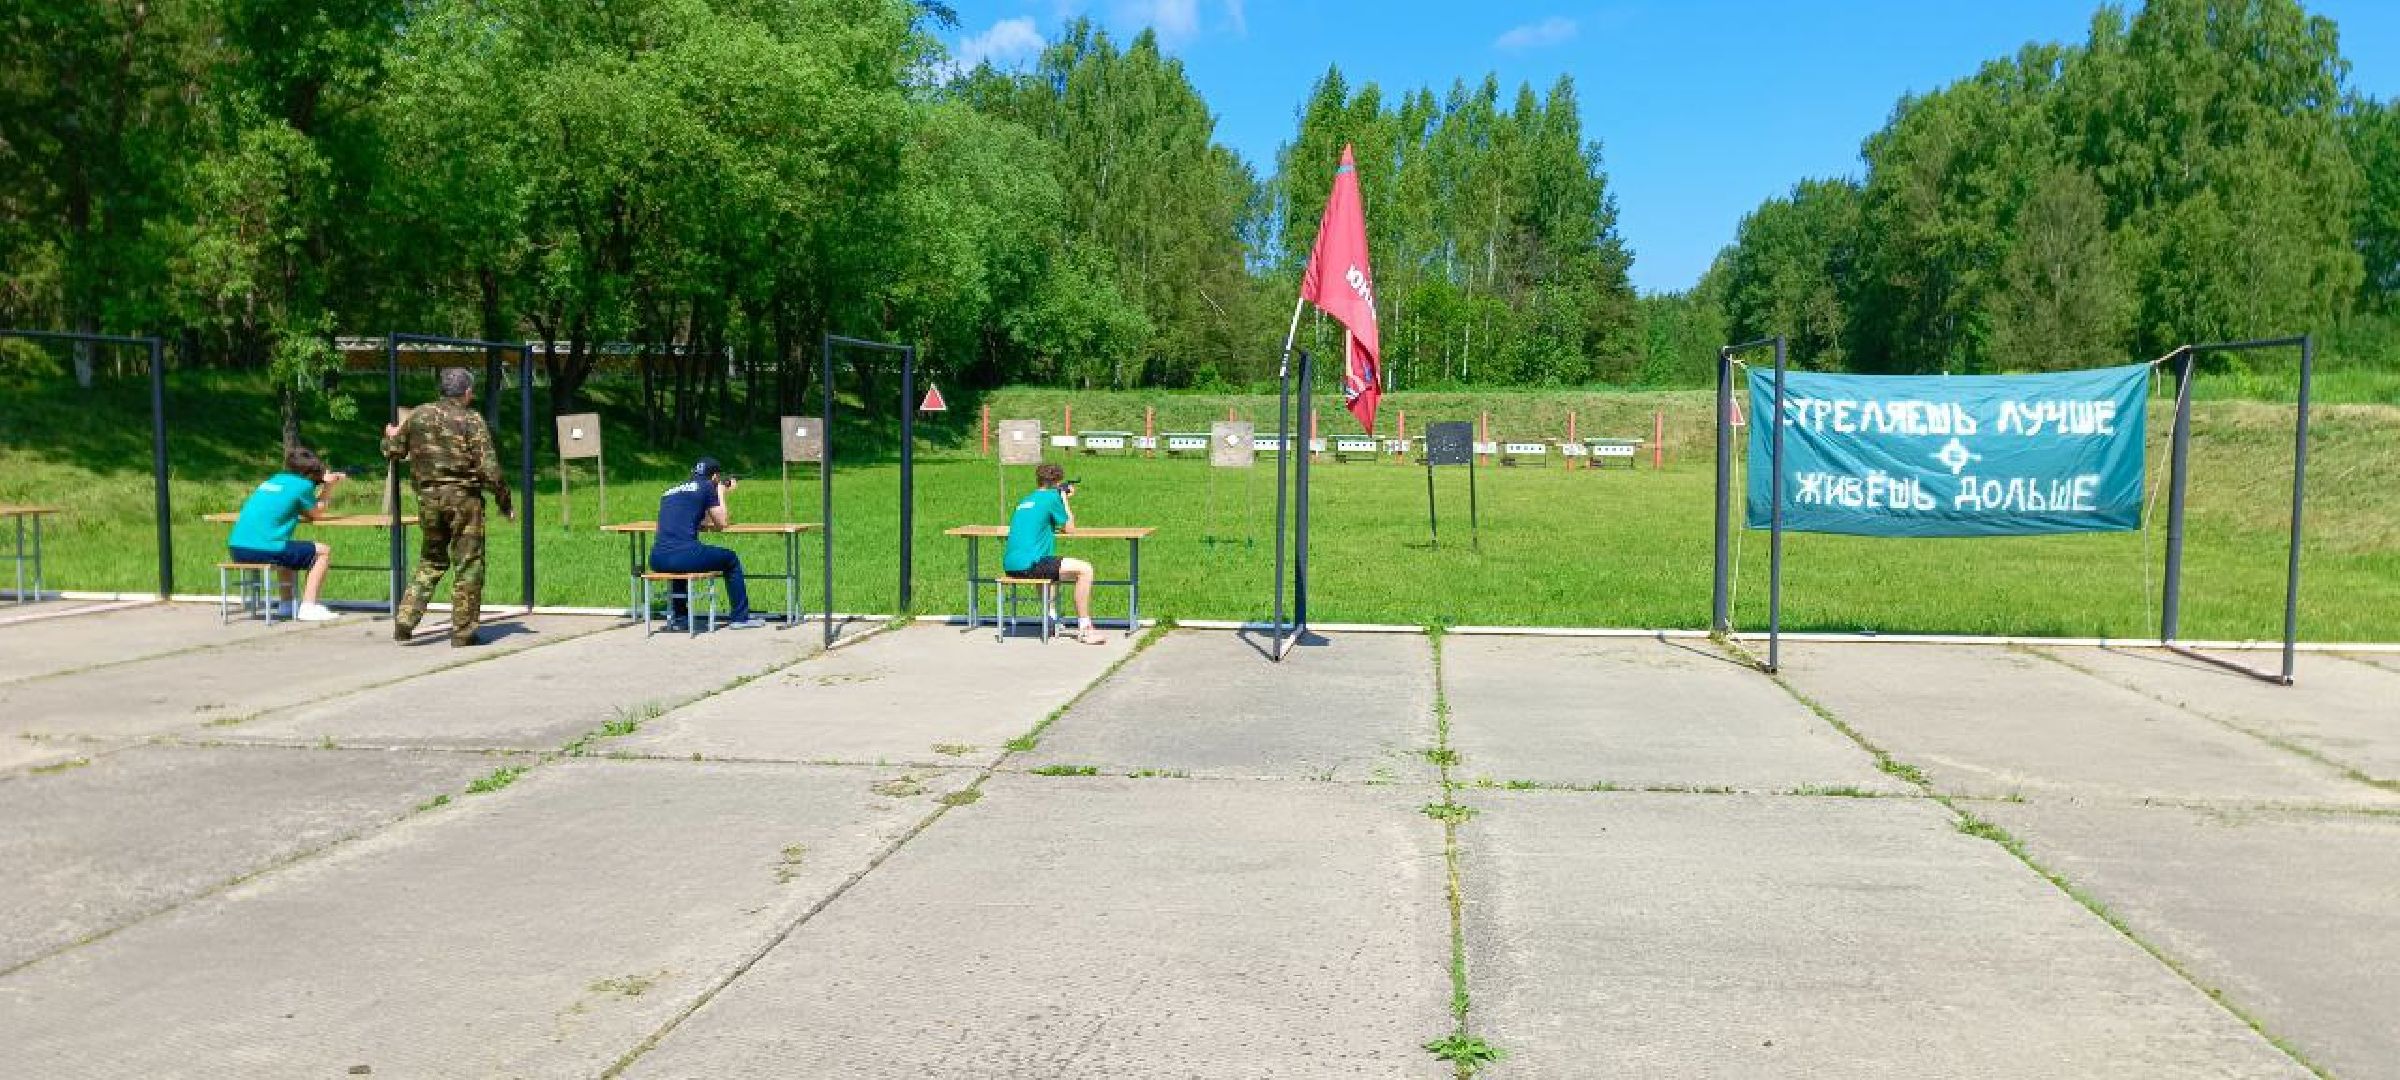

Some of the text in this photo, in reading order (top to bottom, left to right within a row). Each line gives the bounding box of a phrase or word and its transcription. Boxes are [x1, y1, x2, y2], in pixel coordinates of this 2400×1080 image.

[1996, 399, 2117, 436] ЛУЧШЕ
[1795, 469, 2101, 512] ЖИВЁШЬ ДОЛЬШЕ
